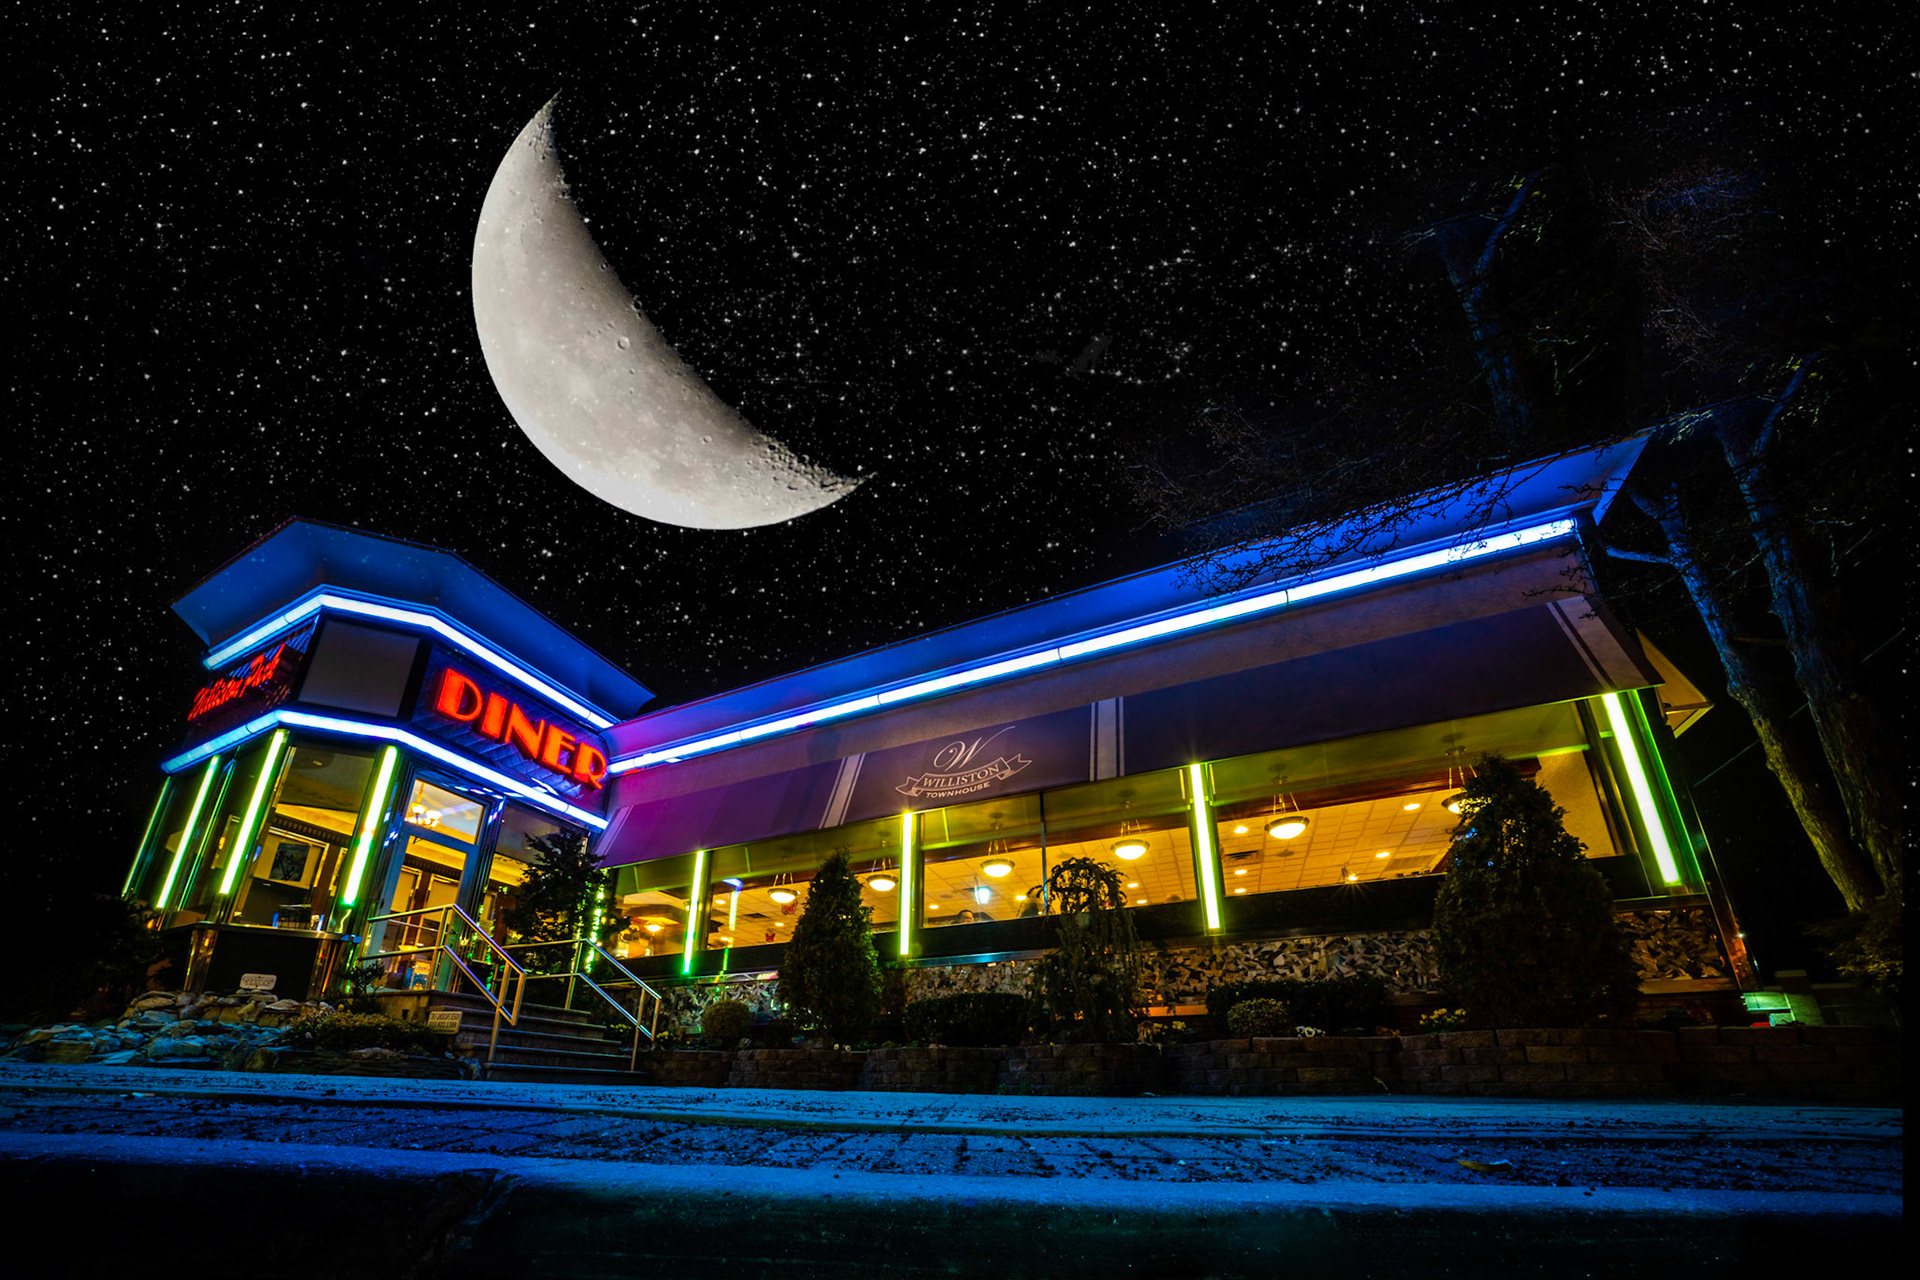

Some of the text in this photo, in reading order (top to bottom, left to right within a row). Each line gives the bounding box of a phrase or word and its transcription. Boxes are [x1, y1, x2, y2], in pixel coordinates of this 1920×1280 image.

[436, 668, 608, 790] DINER
[933, 725, 1016, 772] W
[923, 763, 999, 788] WILLISTON
[926, 781, 991, 799] TOWNHOUSE
